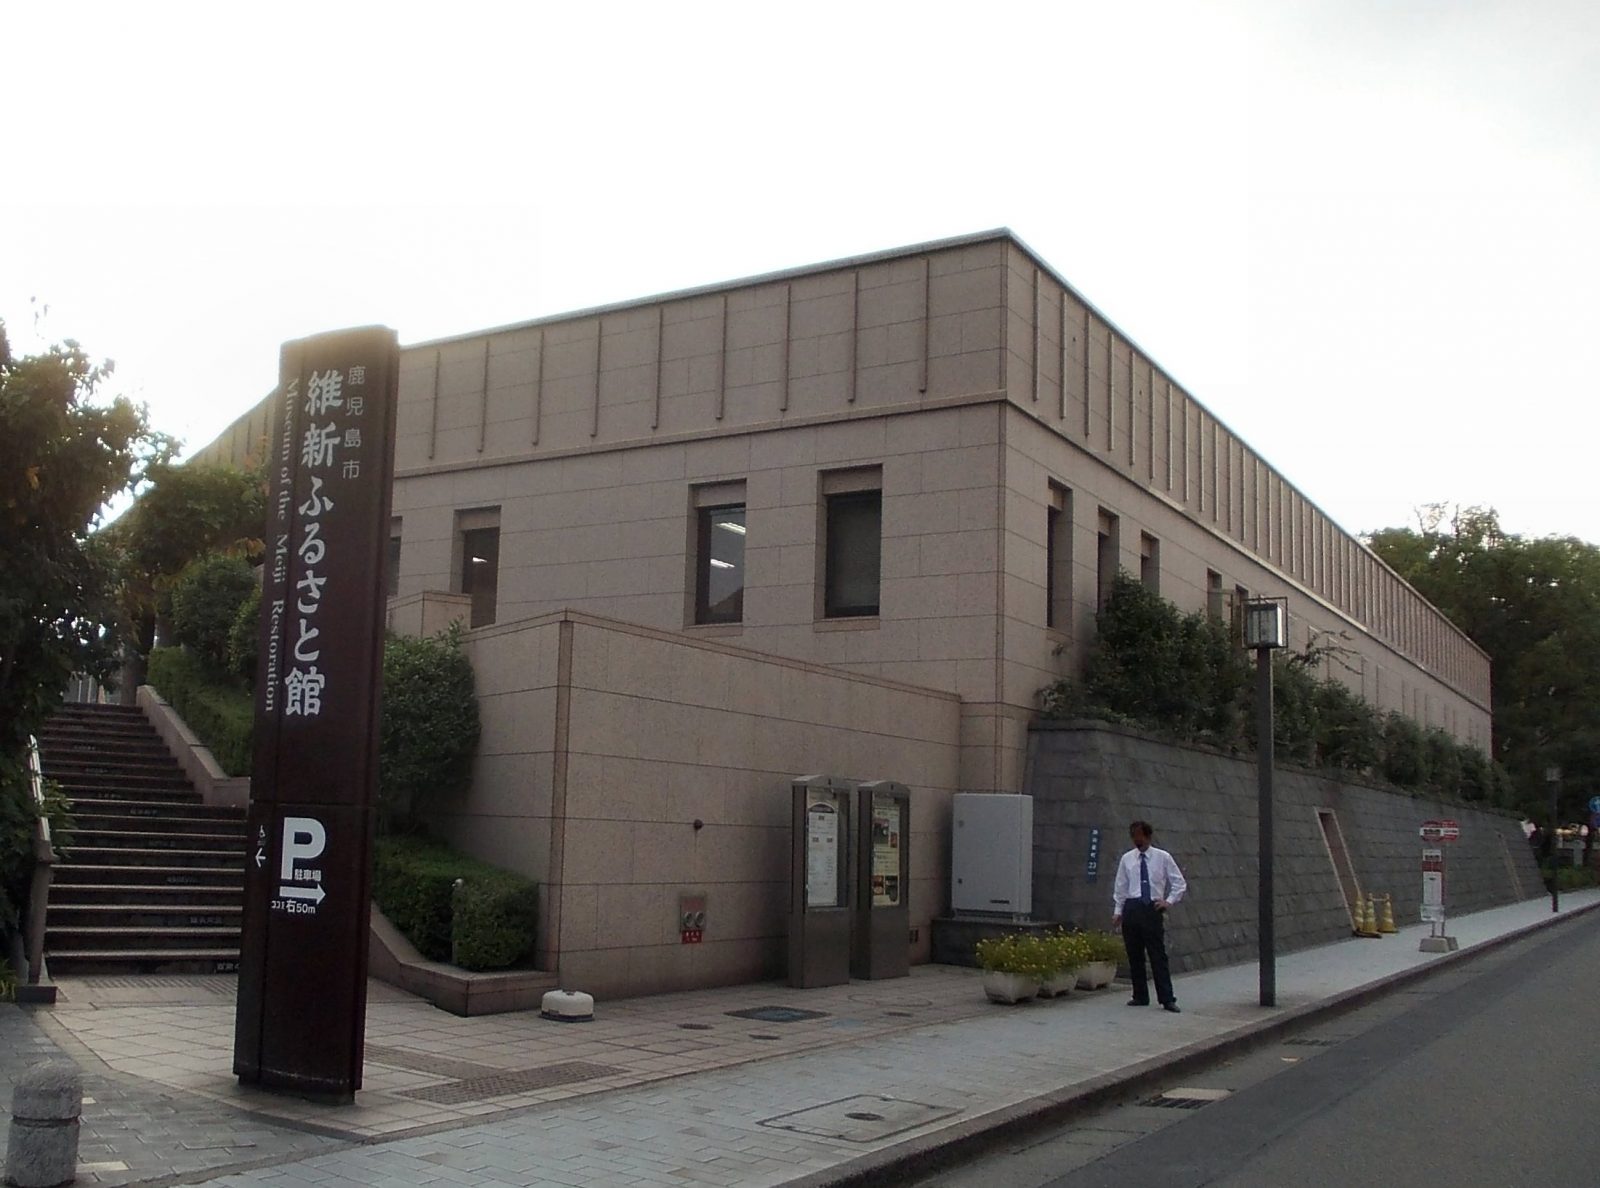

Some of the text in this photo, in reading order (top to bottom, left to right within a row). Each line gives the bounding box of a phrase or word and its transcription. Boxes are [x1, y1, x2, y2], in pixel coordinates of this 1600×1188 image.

[342, 365, 366, 479] 鹿児島市
[265, 378, 299, 712] Museum of the Meiji Restoration
[284, 369, 344, 716] 維新ふるさと館
[281, 816, 326, 880] P
